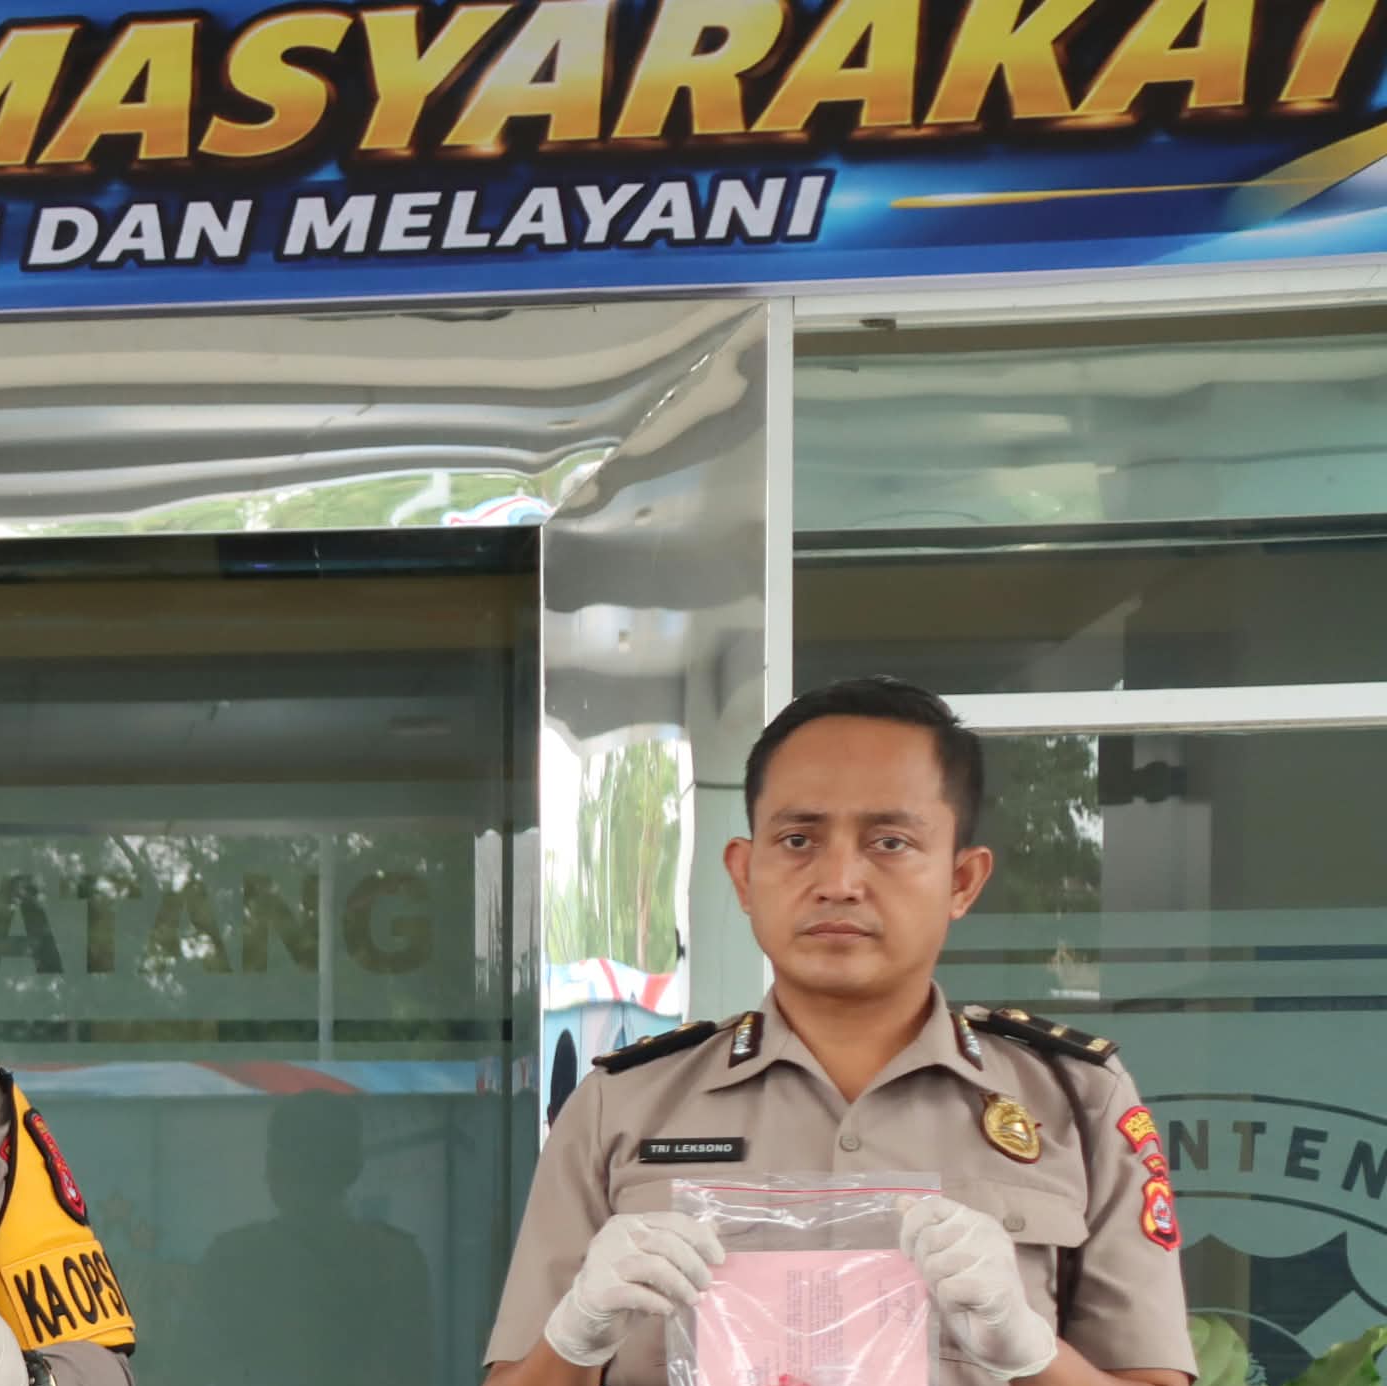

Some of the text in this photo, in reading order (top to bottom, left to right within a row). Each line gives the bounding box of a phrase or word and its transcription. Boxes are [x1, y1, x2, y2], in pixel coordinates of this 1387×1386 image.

[27, 197, 253, 268] DAN
[283, 175, 831, 254] MELAYANI
[650, 1143, 733, 1153] TRI LEKSONO
[1168, 1119, 1387, 1200] NTEN
